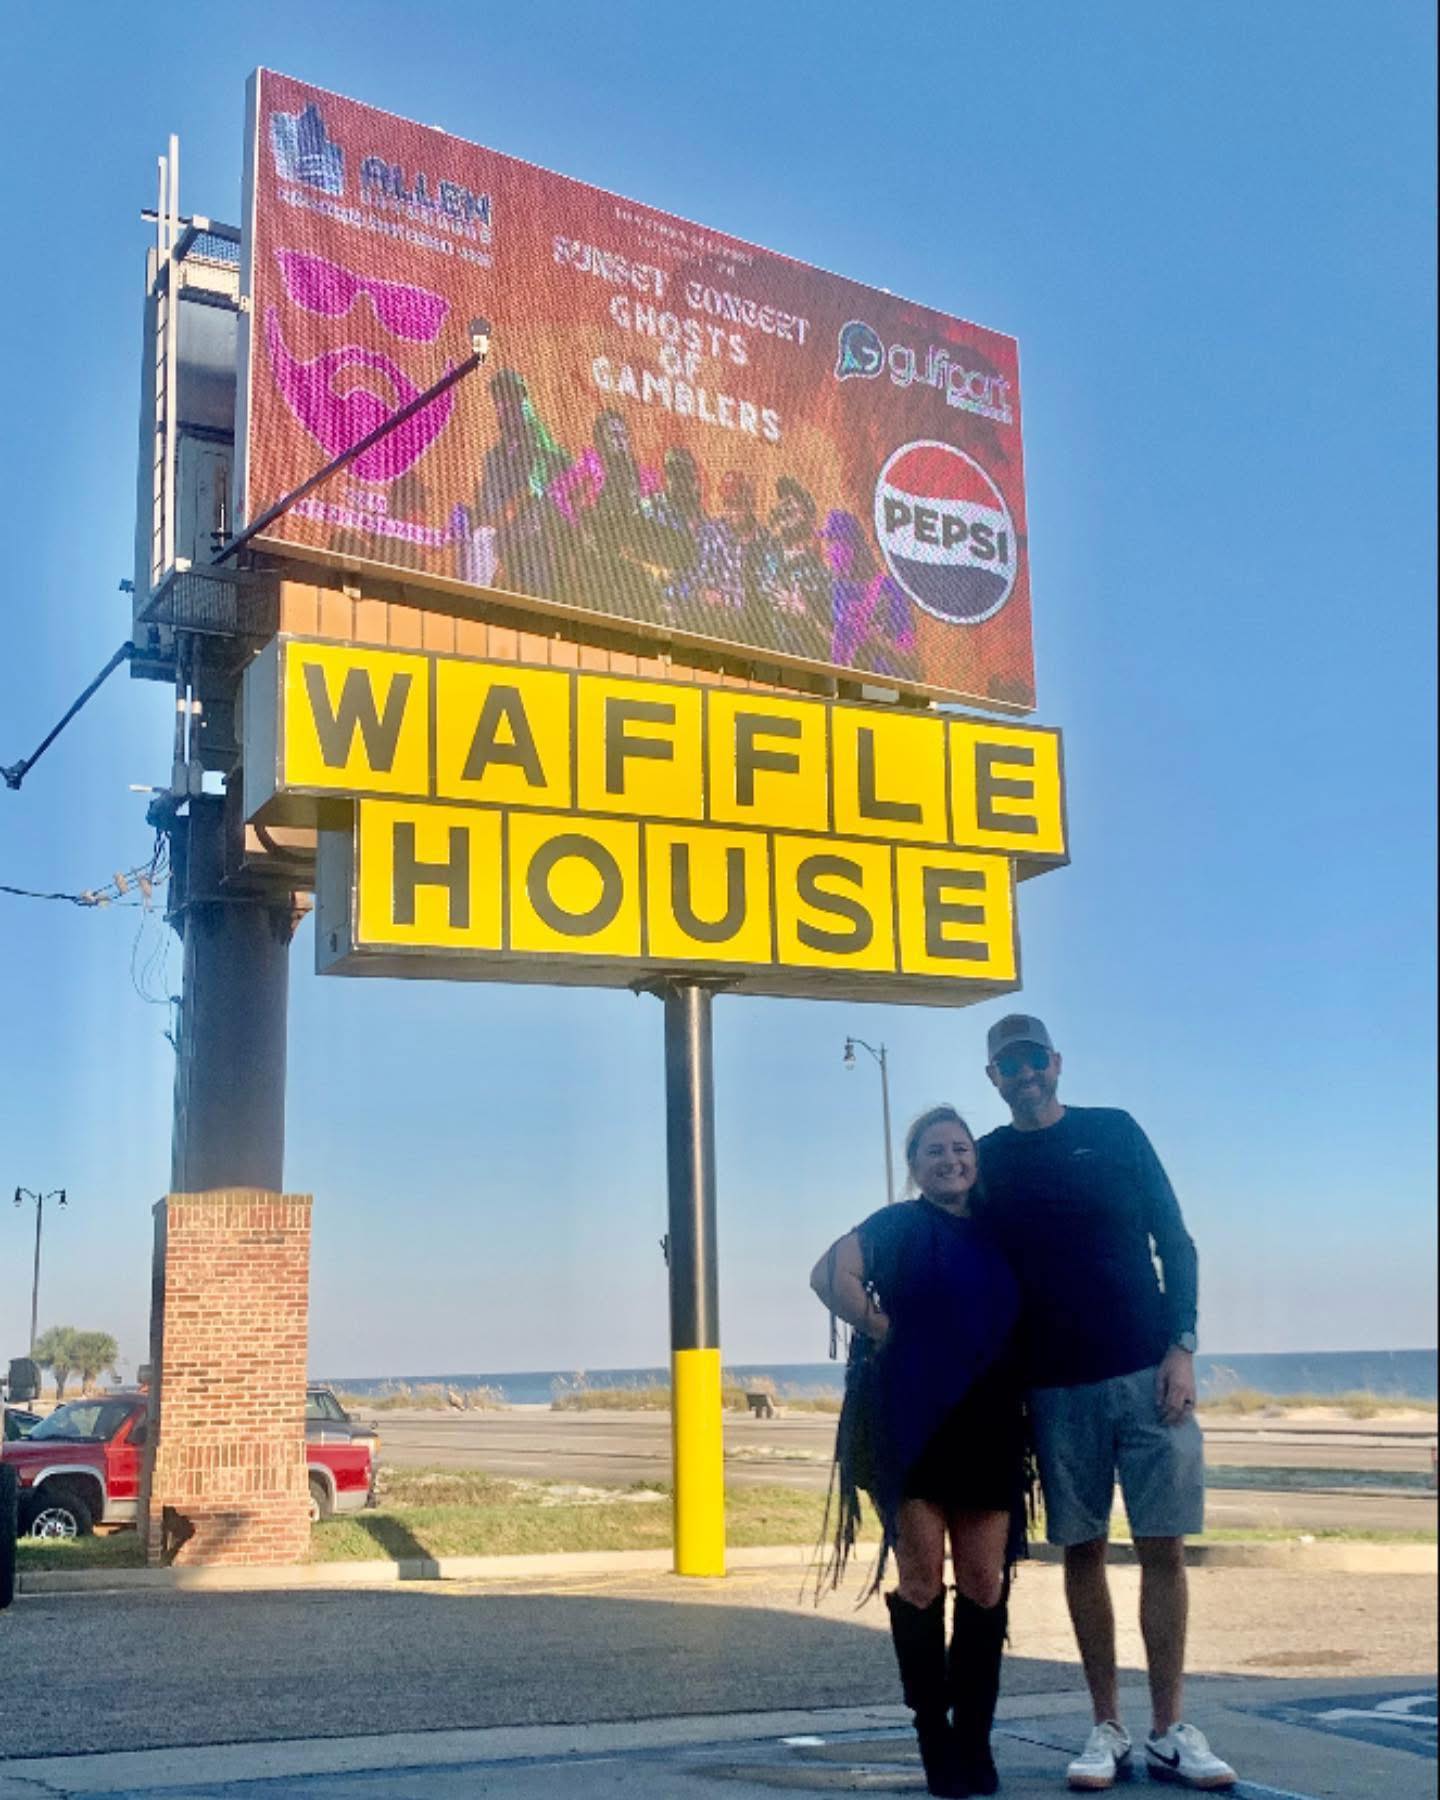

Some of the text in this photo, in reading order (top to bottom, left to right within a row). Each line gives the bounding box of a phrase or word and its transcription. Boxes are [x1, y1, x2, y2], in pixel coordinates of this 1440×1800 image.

[361, 156, 491, 227] ALLEN
[609, 294, 749, 366] GHOSTS
[685, 280, 810, 345] CONCERT
[659, 339, 702, 380] OF
[888, 343, 1010, 407] gulfport
[591, 355, 781, 442] GAMBLERS
[883, 498, 1008, 564] PEPSI
[302, 662, 1039, 835] WAFFLE
[392, 821, 990, 962] HOUSE
